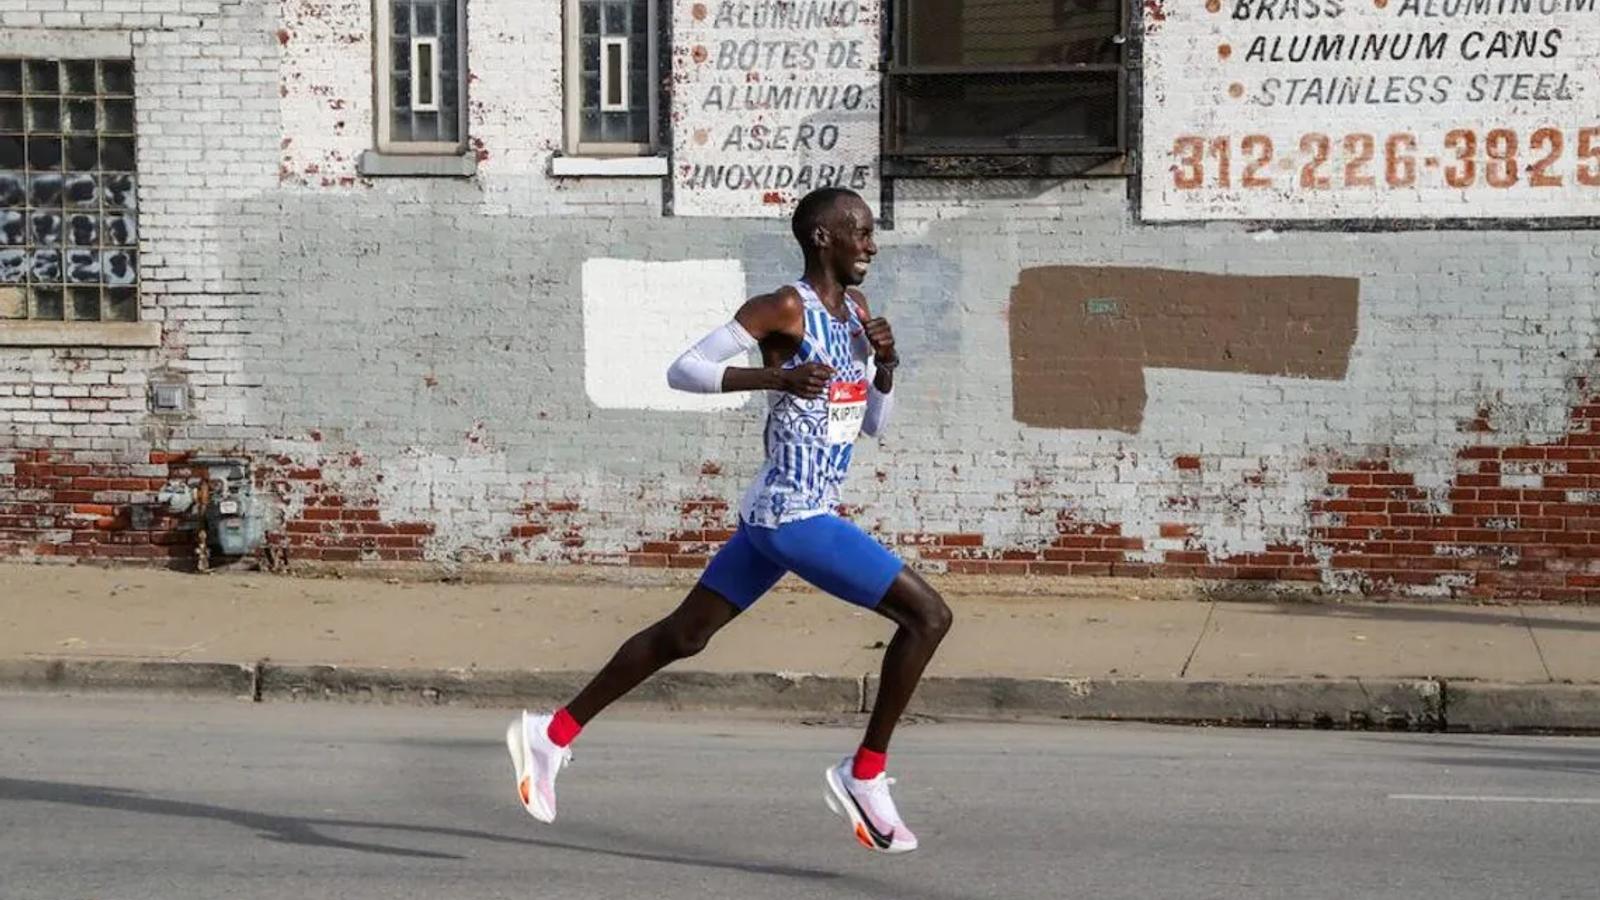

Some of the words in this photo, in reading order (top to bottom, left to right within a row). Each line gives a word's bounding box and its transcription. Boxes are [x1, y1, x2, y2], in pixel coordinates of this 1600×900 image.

[713, 0, 858, 29] ALUMINIO
[1231, 0, 1345, 21] BRASS
[716, 39, 819, 70] BOTES
[826, 40, 864, 69] DE
[1245, 31, 1448, 62] ALUMINUM
[1460, 28, 1563, 60] CANS
[702, 84, 862, 110] ALUMINIO
[1258, 75, 1453, 107] STAINLESS
[1466, 73, 1575, 102] STEEL
[721, 124, 839, 151] ASERO
[681, 163, 870, 190] INOXIDABLE
